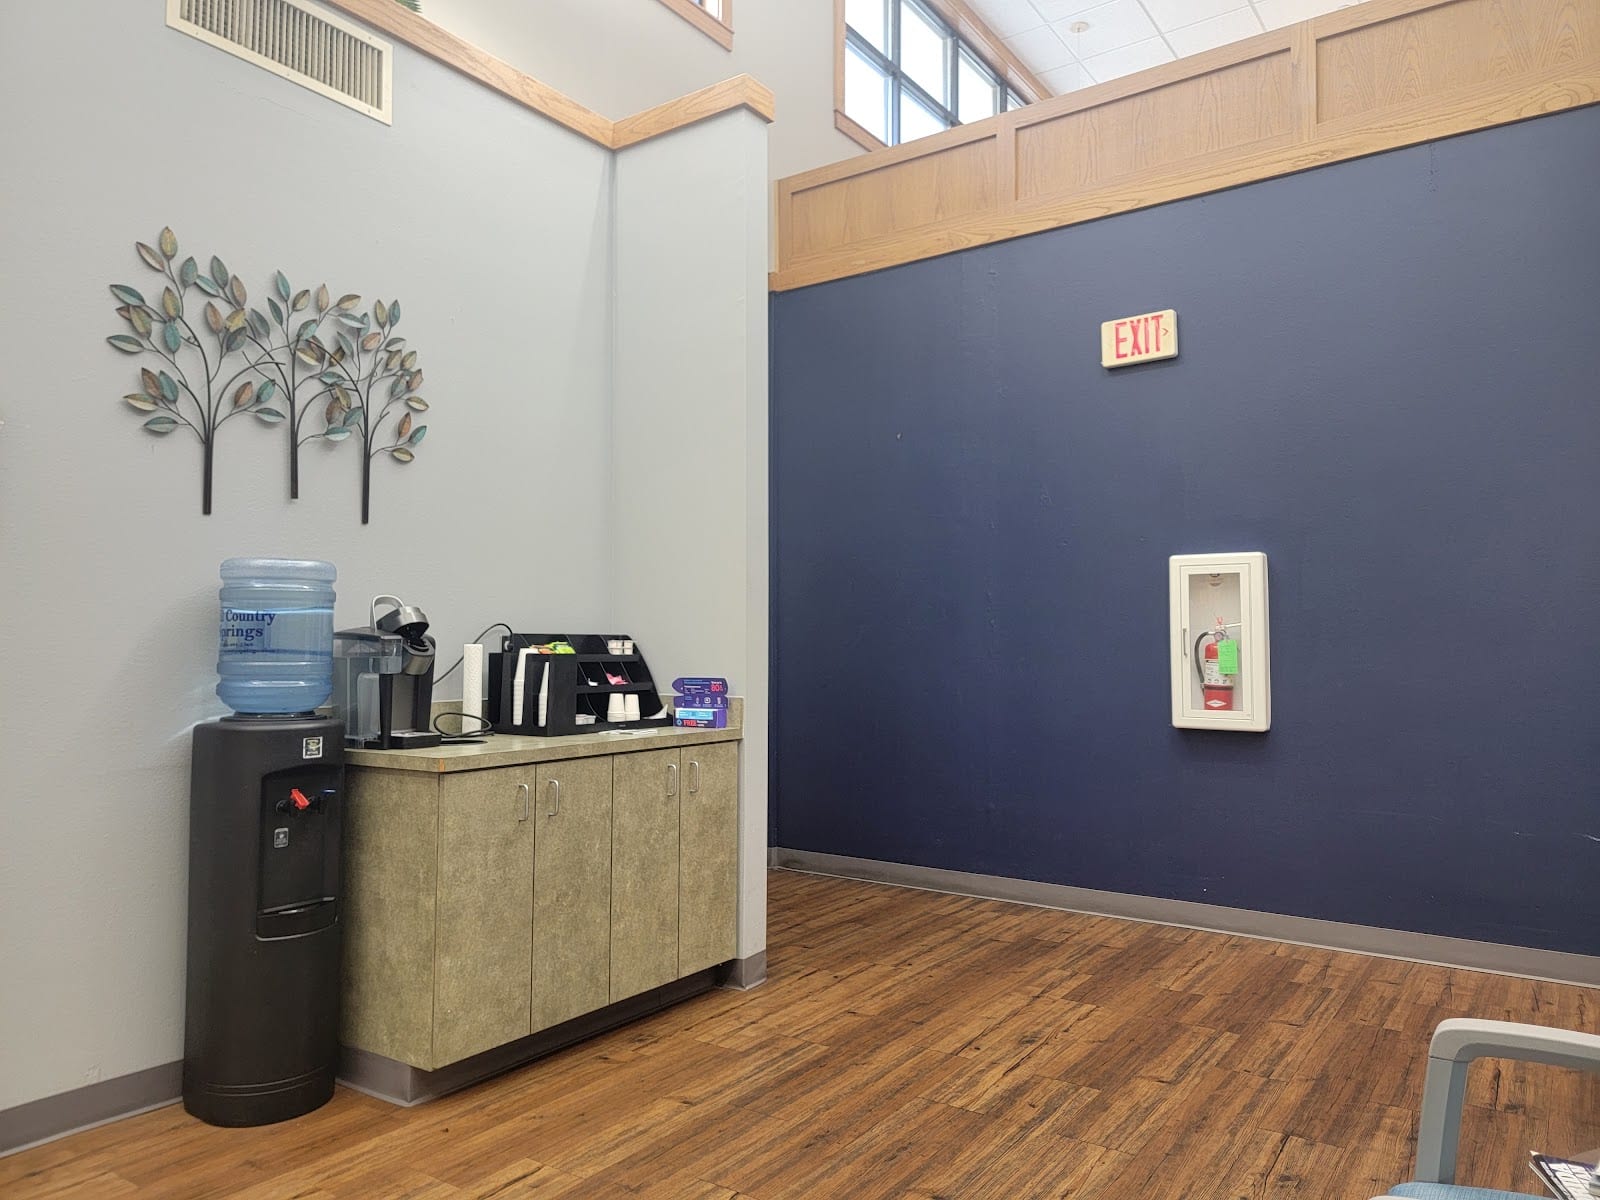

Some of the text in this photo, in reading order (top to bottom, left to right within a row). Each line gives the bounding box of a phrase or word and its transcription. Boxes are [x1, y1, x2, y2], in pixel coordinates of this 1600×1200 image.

[1115, 314, 1164, 359] EXIT
[226, 609, 276, 626] Country
[220, 624, 264, 642] prings
